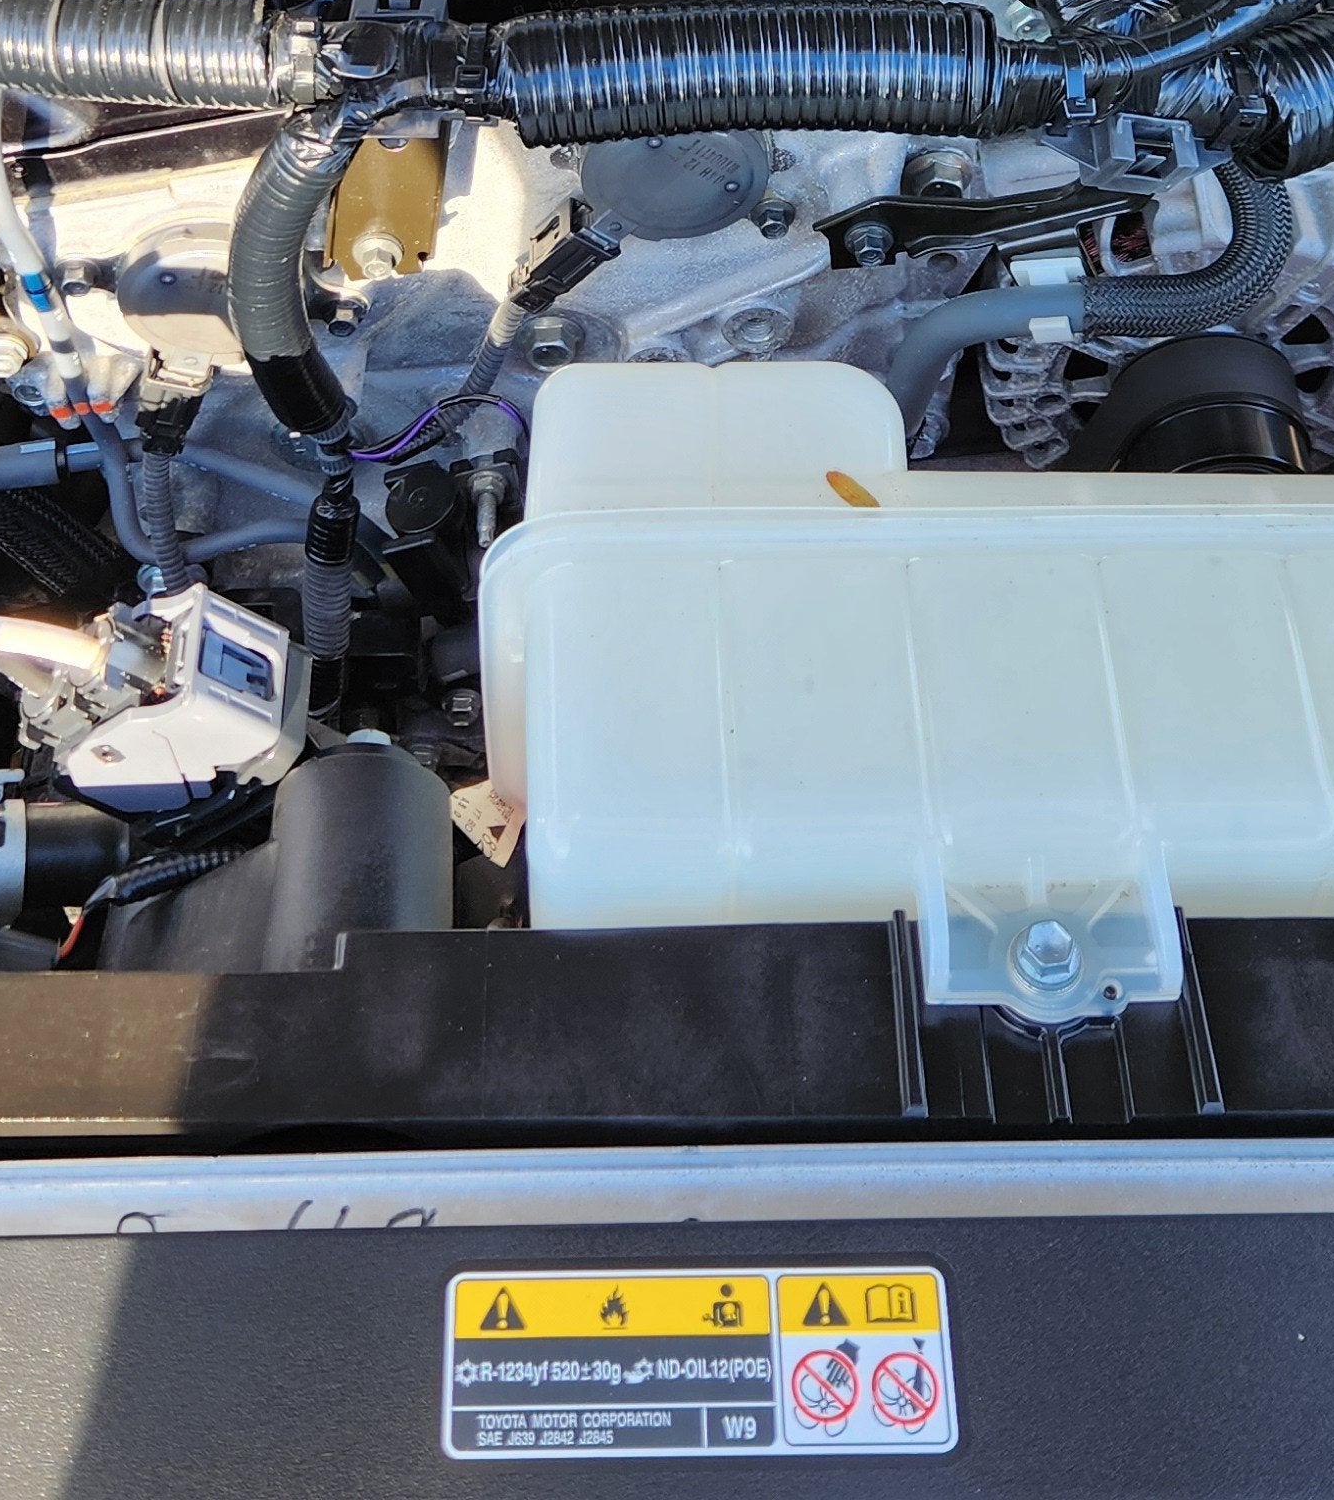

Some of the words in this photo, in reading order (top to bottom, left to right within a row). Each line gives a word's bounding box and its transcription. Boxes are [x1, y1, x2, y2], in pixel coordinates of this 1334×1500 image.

[477, 1414, 529, 1431] TOYOTA
[532, 1413, 579, 1429] MOTOR
[582, 1411, 672, 1429] CORPORATION
[722, 1416, 758, 1440] W9
[476, 1431, 505, 1447] SAE
[508, 1431, 536, 1447] J639
[539, 1430, 576, 1446] J2842
[578, 1430, 615, 1445] J2845
